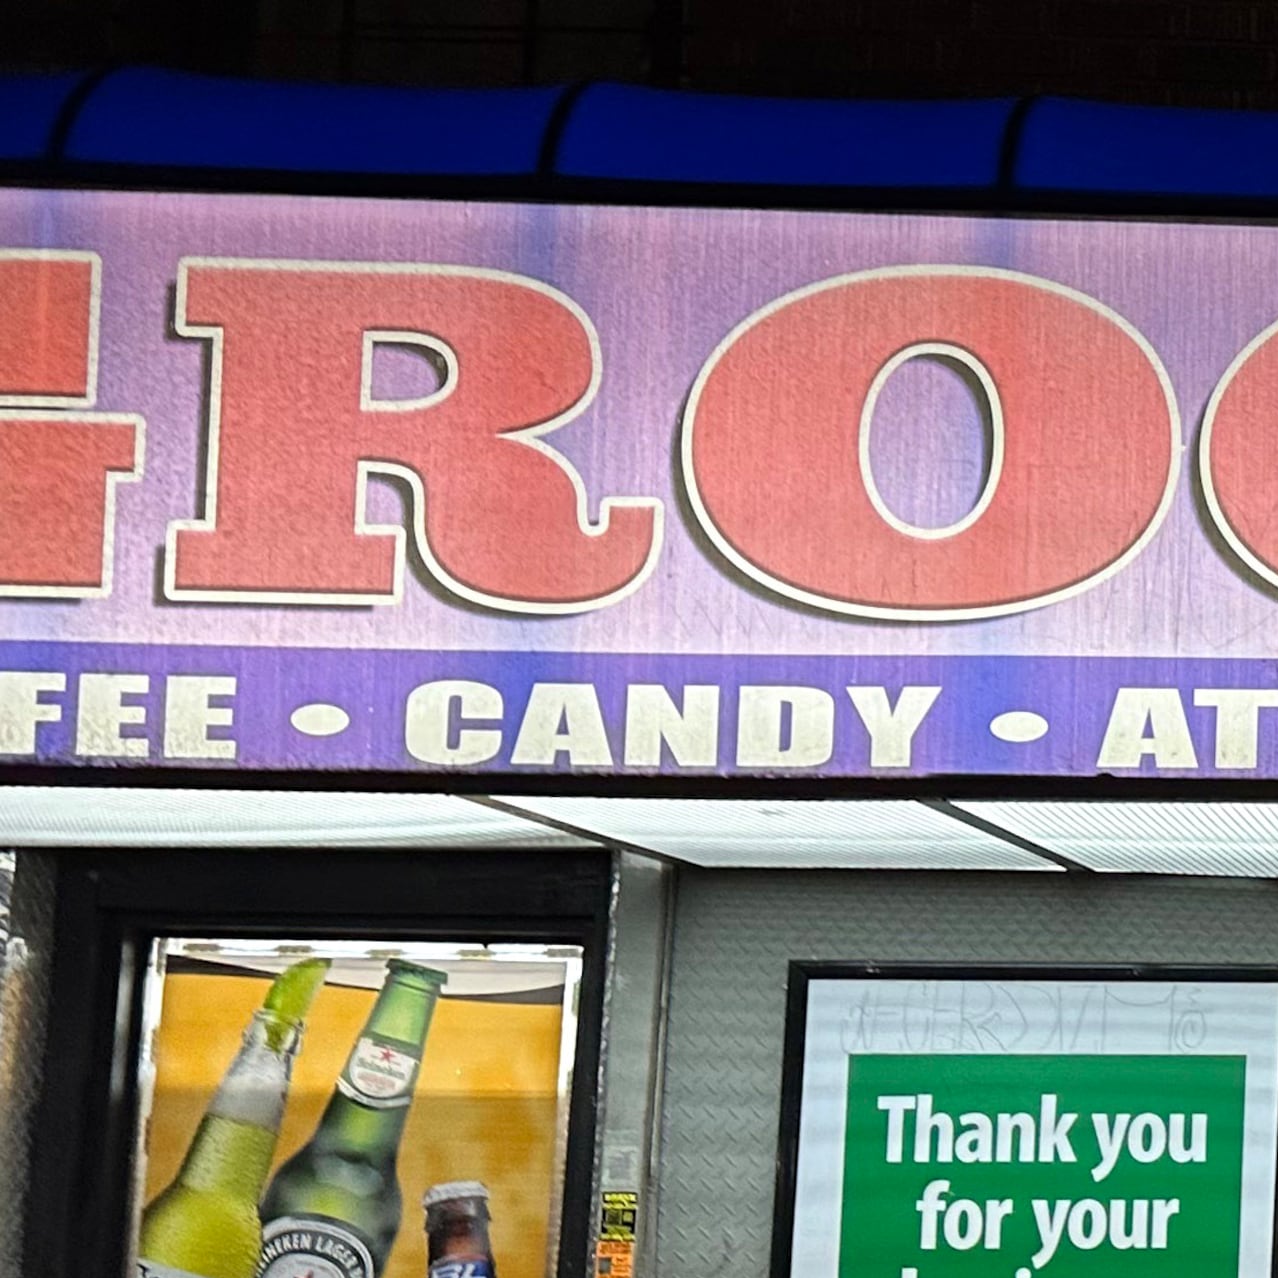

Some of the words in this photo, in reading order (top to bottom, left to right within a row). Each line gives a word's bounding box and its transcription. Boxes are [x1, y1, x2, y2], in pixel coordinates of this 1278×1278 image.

[404, 679, 942, 769] CANDY
[877, 1094, 1079, 1163] Thank
[1090, 1112, 1208, 1183] you
[915, 1179, 1014, 1250] for
[1030, 1197, 1180, 1270] your
